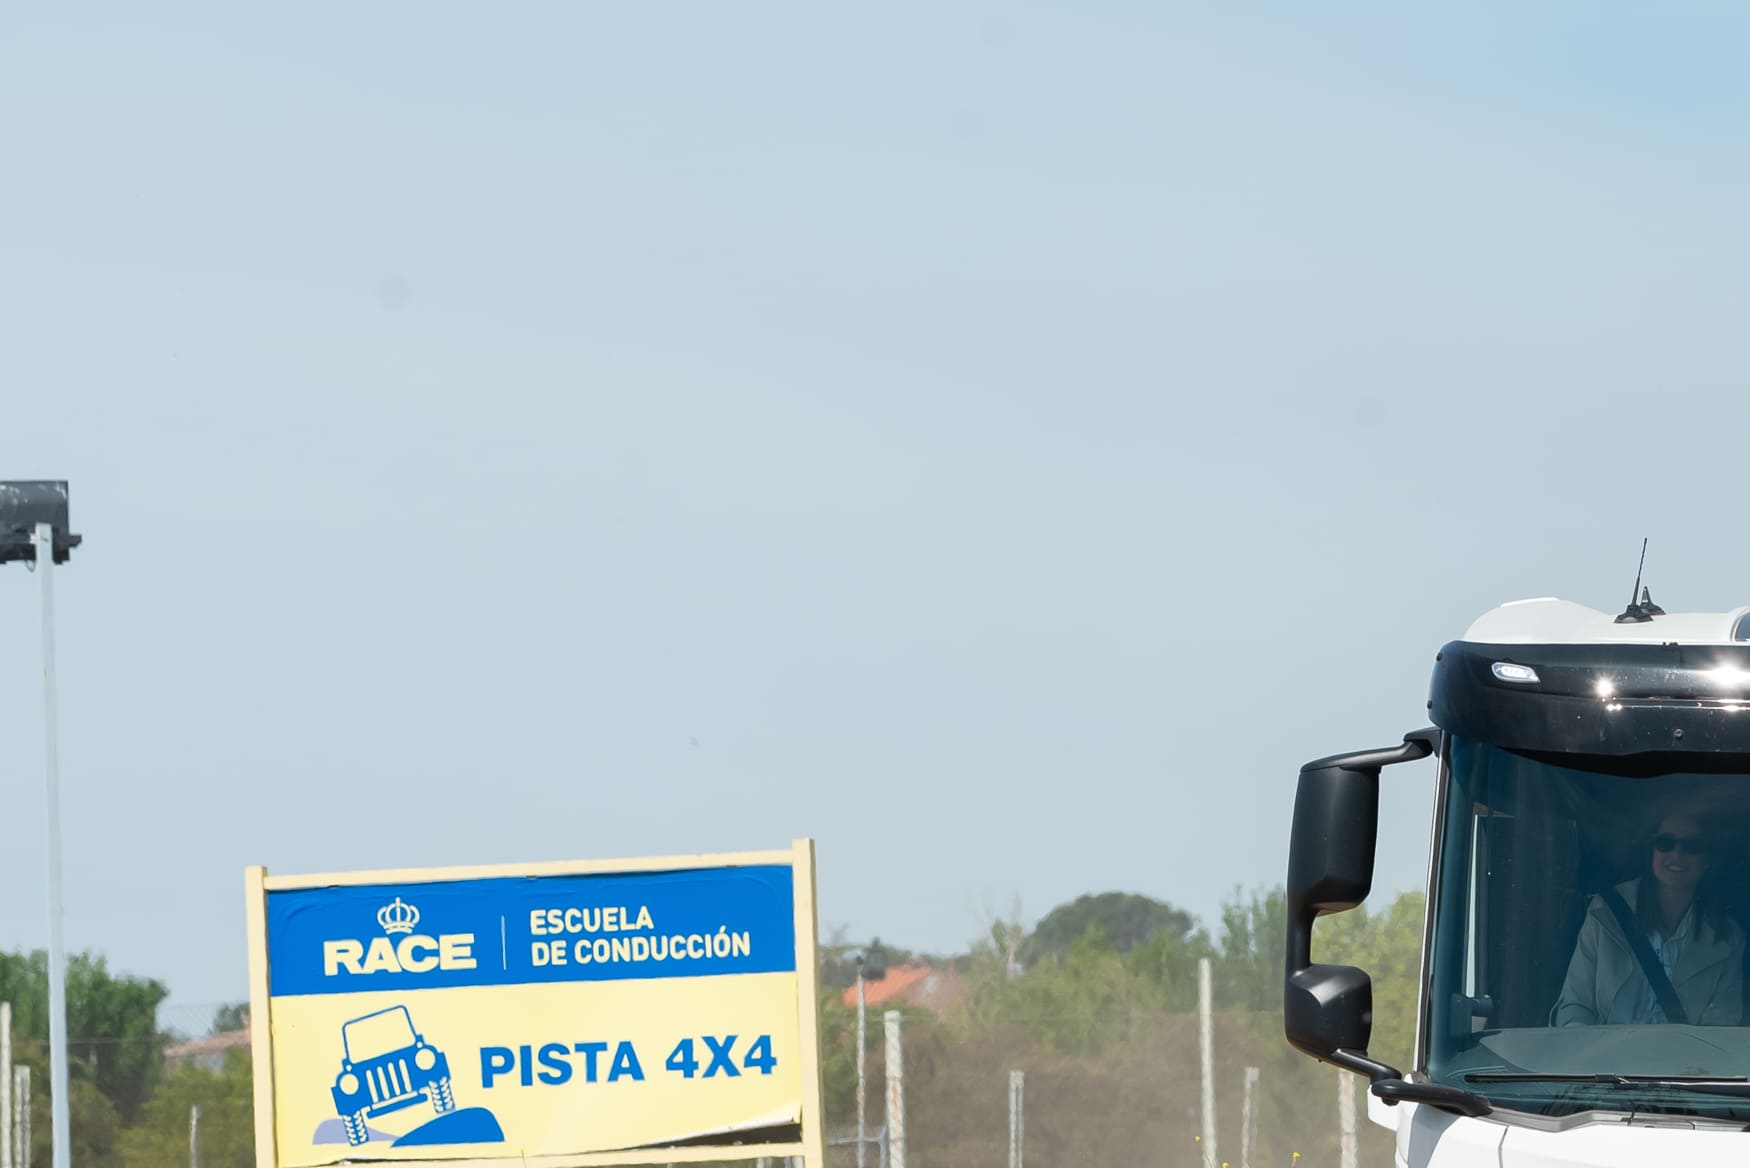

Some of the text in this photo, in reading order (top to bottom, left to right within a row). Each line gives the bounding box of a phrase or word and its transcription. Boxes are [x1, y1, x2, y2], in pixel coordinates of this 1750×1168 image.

[530, 906, 654, 935] ESCUELA
[323, 933, 477, 976] RACE
[532, 925, 750, 966] DE CONDUCCIÓN
[480, 1034, 777, 1088] PISTA 4X4
